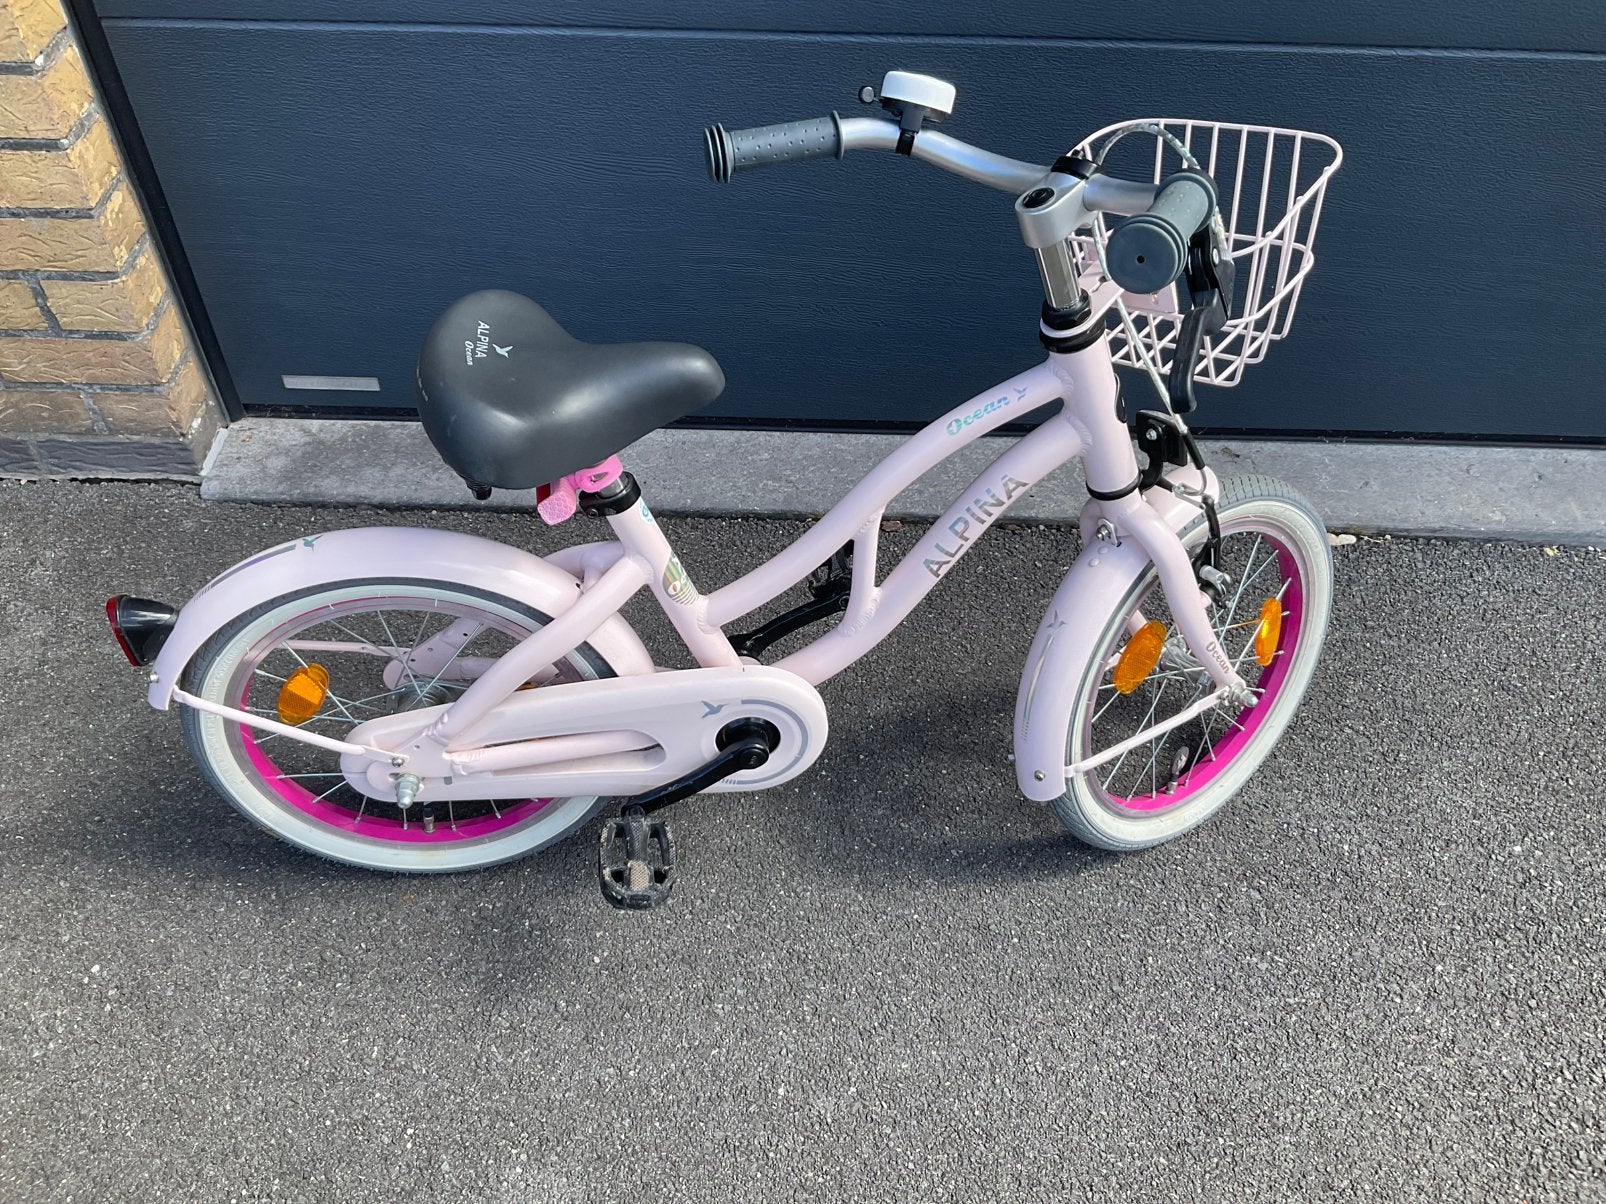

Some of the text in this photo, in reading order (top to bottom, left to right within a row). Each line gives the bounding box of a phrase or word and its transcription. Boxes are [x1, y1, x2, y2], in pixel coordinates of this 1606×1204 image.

[464, 340, 475, 366] Ocean
[474, 320, 490, 358] ALPINA
[946, 394, 1010, 436] Ocean
[922, 474, 1030, 579] ALPINA
[1206, 641, 1231, 674] Ocean
